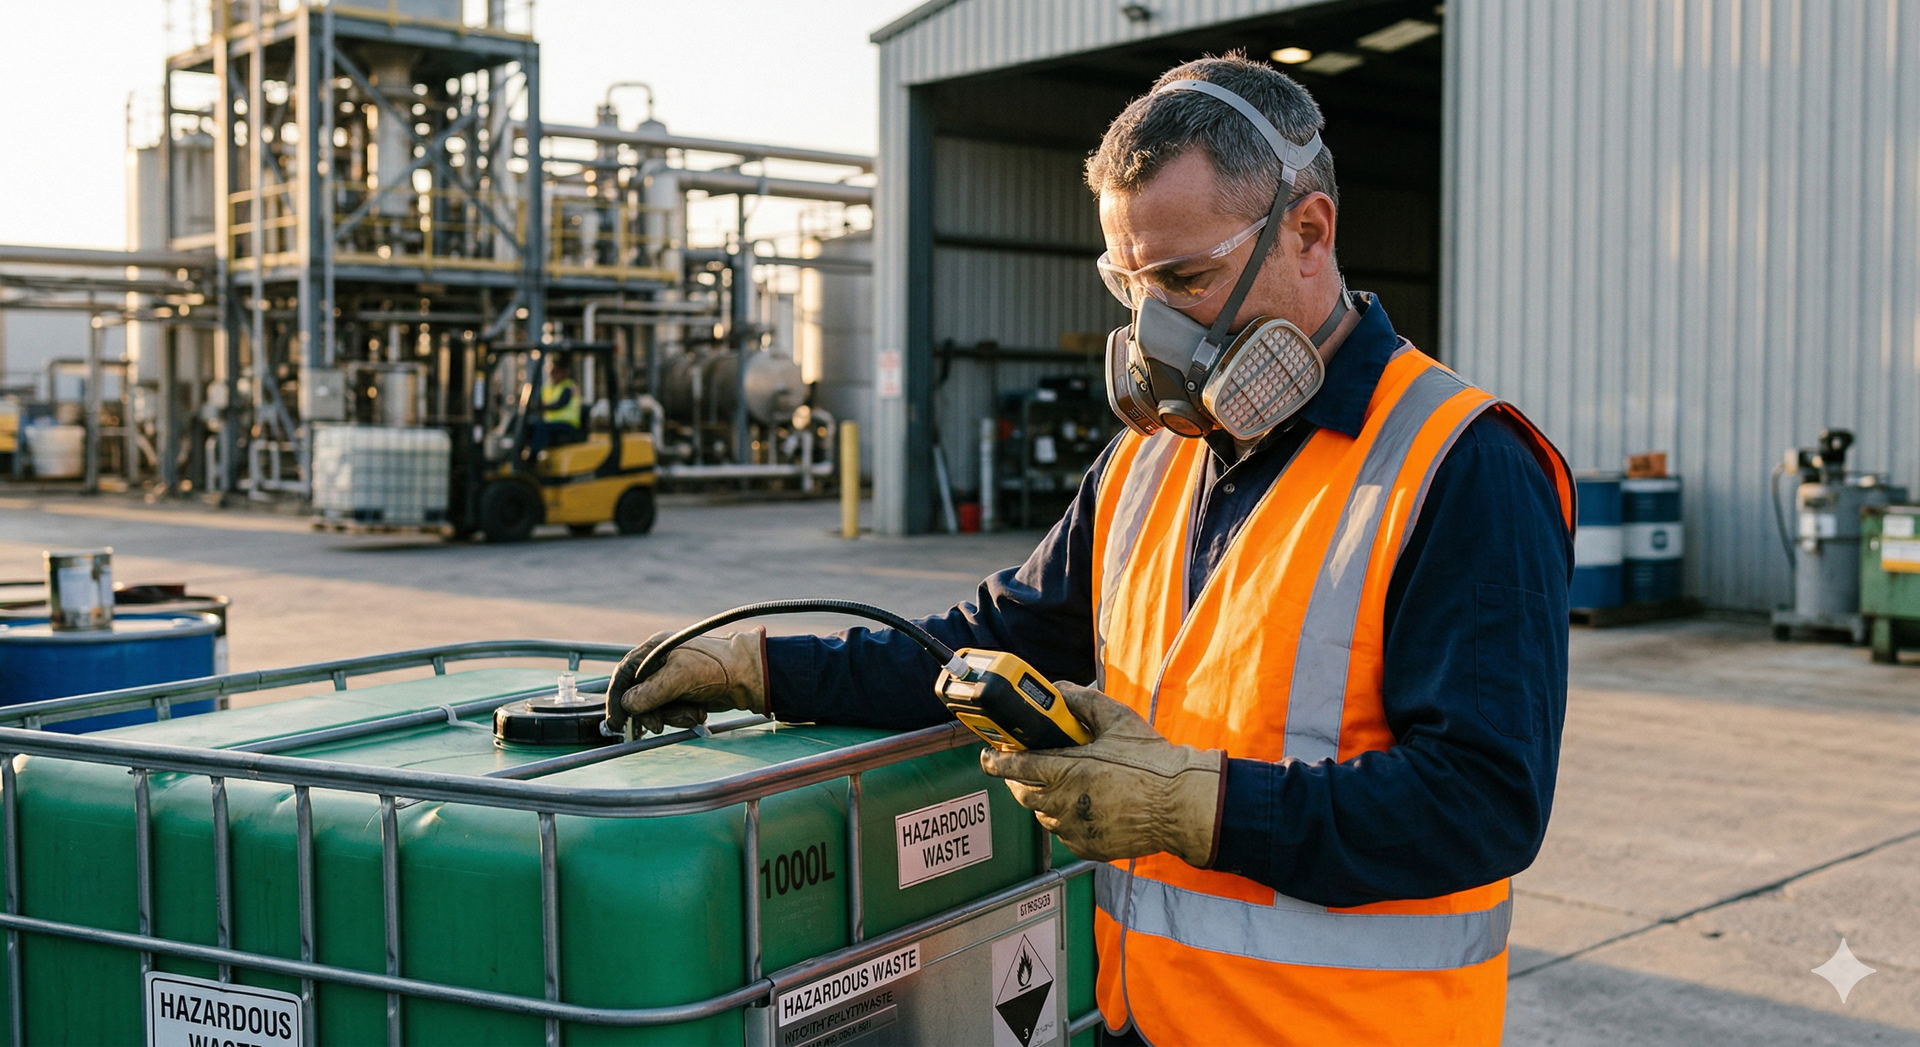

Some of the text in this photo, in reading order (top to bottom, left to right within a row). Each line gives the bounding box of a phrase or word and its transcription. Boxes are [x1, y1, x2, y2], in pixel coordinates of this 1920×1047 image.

[902, 802, 985, 847] HAZARDOUS
[760, 842, 836, 899] 1000L
[922, 834, 970, 868] WASTE
[784, 949, 917, 1019] HAZARDOUS WASTE
[160, 992, 292, 1040] HAZARDOUS
[1023, 1028, 1030, 1039] 3
